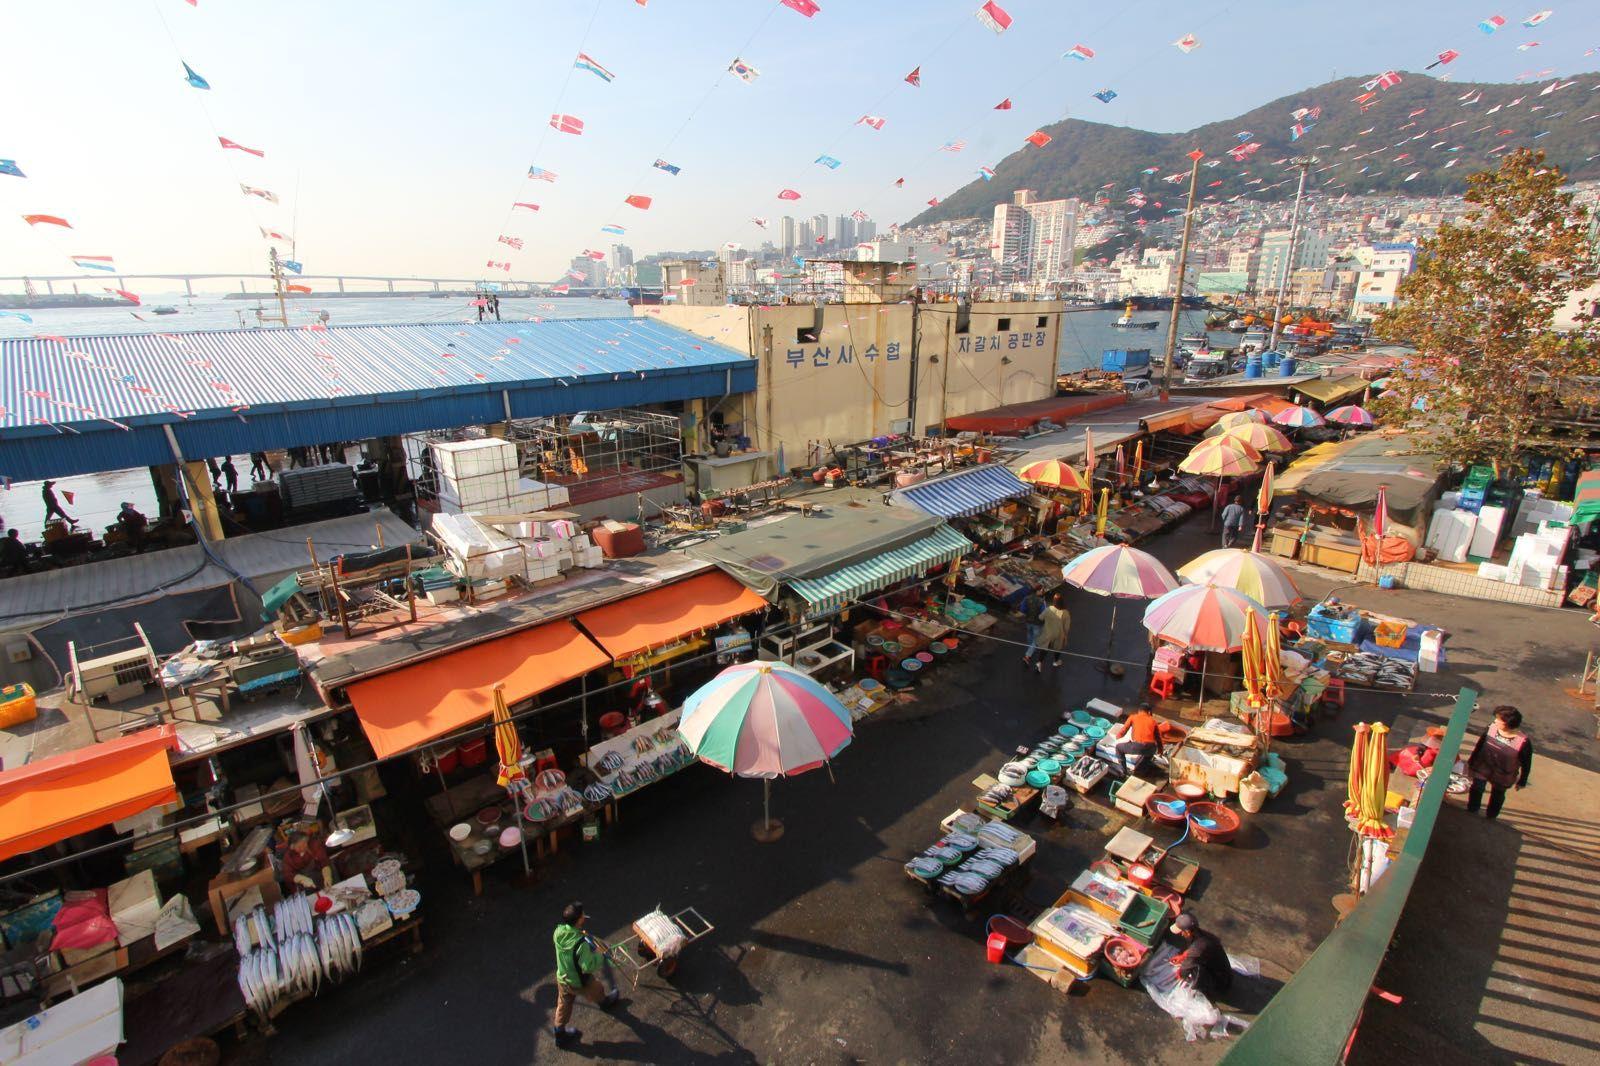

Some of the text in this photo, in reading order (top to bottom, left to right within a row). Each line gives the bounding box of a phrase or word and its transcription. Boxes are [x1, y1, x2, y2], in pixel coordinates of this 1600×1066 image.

[786, 341, 901, 369] 부산시 수협
[958, 331, 1047, 354] 자갈치 공판장
